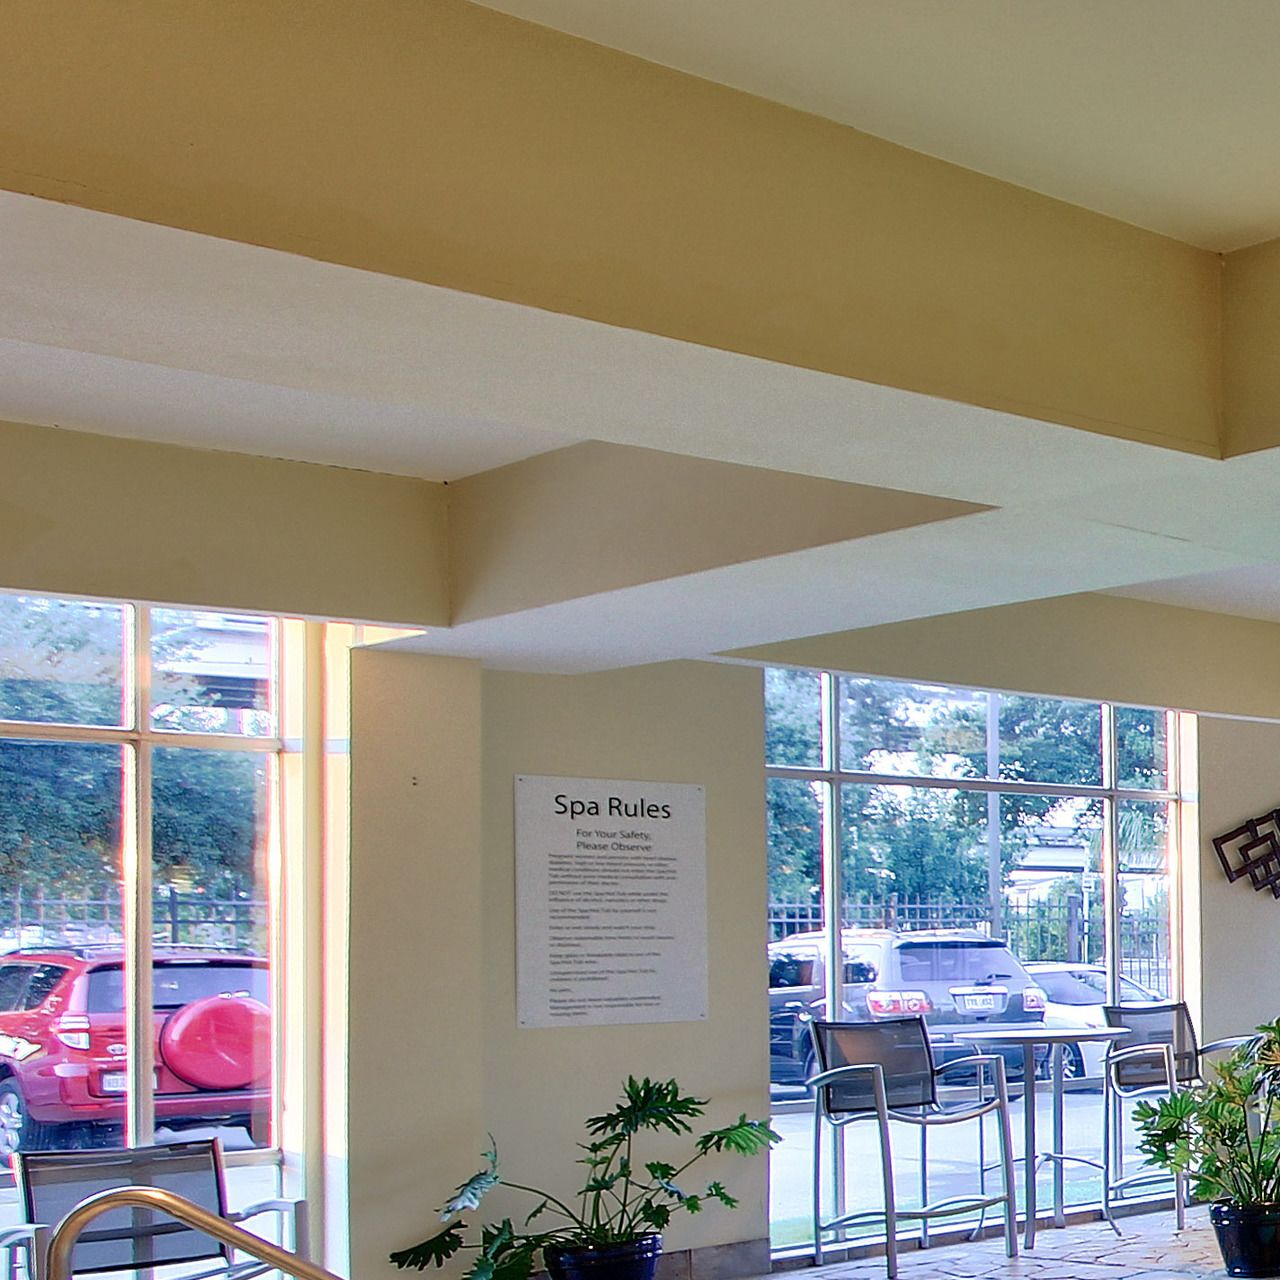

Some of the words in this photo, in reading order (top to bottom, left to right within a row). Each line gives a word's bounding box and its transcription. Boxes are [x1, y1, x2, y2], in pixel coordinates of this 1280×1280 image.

[554, 794, 599, 820] Spa
[608, 797, 671, 819] Rules
[576, 828, 592, 838] For
[595, 829, 616, 839] Your
[576, 841, 608, 851] Please
